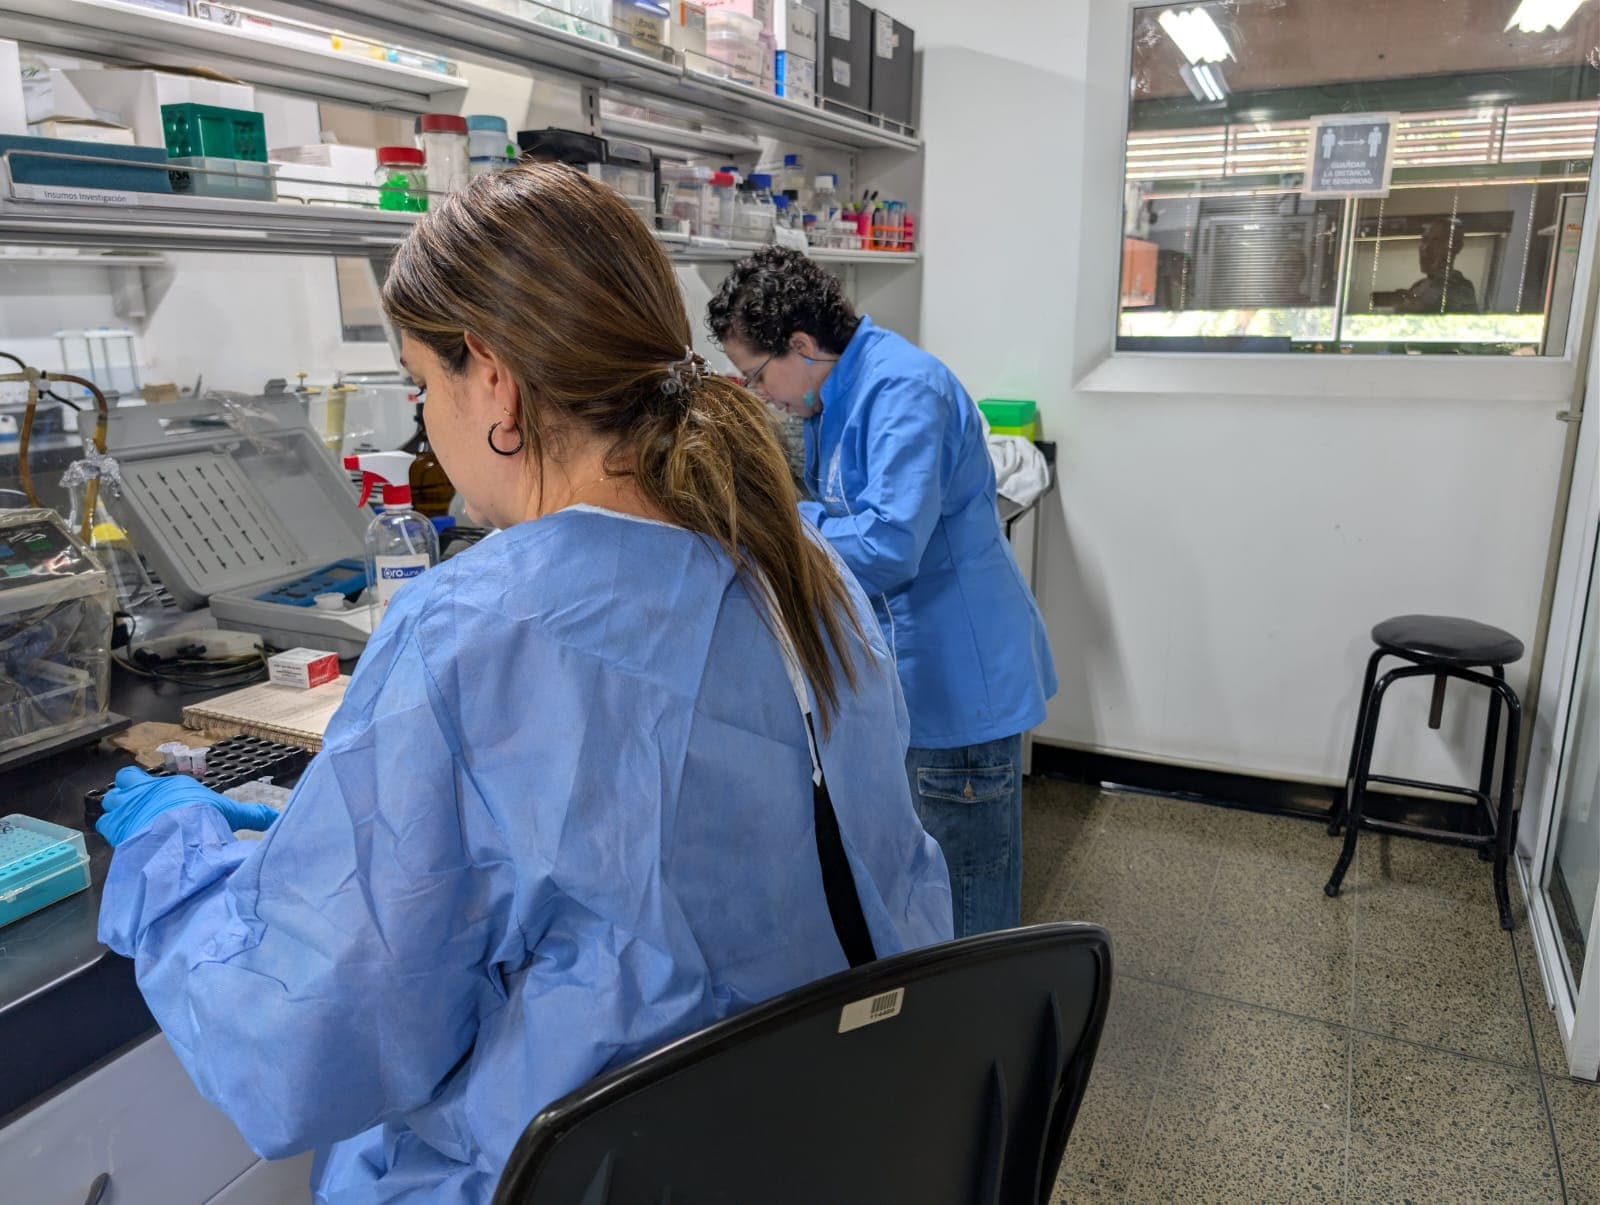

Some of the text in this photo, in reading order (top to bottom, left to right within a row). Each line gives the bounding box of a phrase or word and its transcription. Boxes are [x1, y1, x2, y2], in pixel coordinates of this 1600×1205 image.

[1330, 161, 1366, 169] GUARDAR
[1335, 169, 1372, 177] DISTANCIA
[1332, 177, 1374, 185] SEGURIDAD
[44, 191, 127, 203] Insumos Investigación
